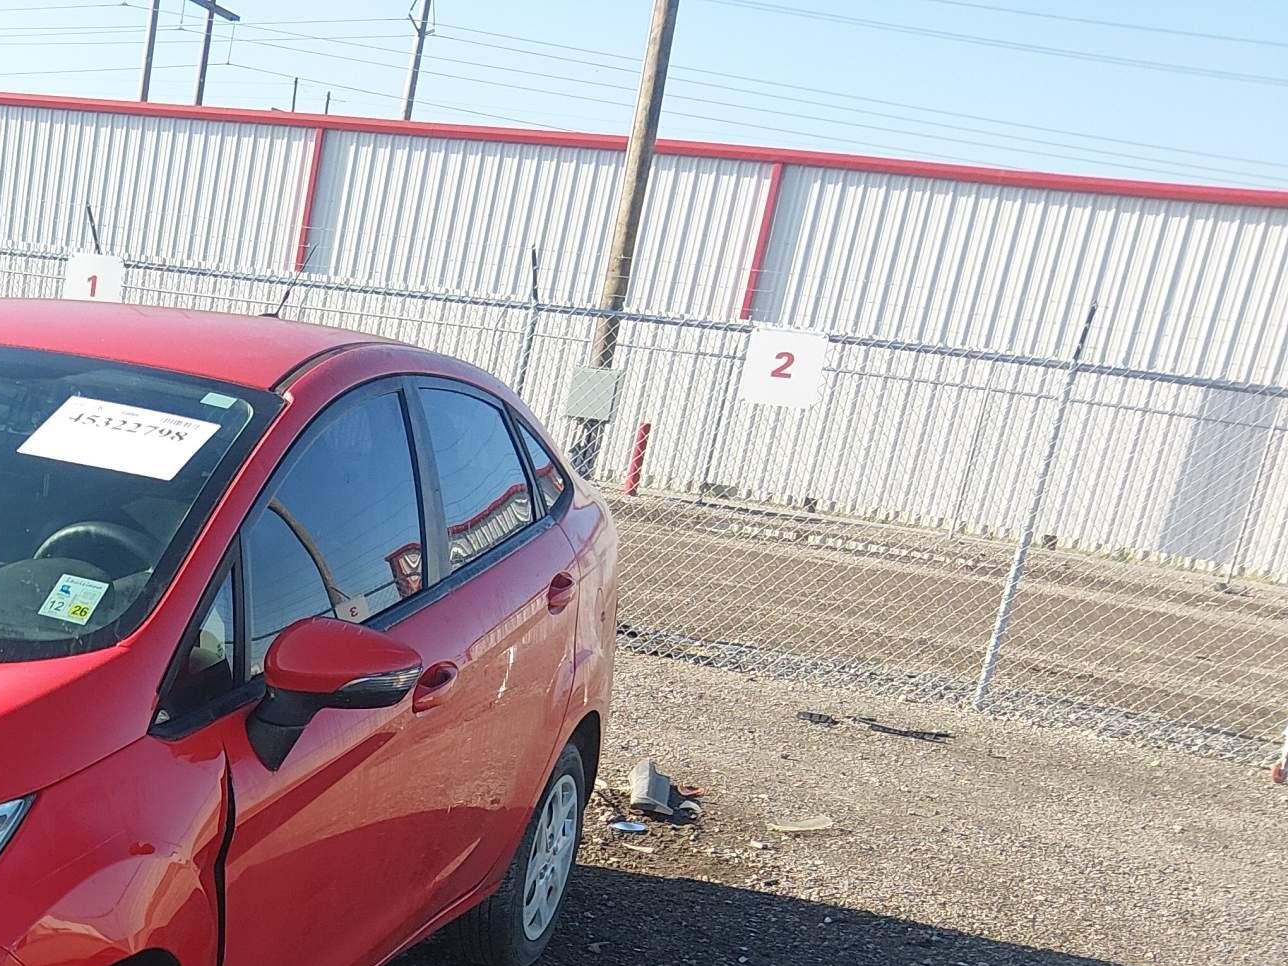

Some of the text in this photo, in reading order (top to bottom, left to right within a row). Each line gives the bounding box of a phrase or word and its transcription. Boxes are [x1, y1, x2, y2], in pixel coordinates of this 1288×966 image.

[87, 274, 98, 297] 1
[770, 351, 795, 379] 2
[68, 413, 188, 441] 45322798
[49, 600, 90, 617] 12 26
